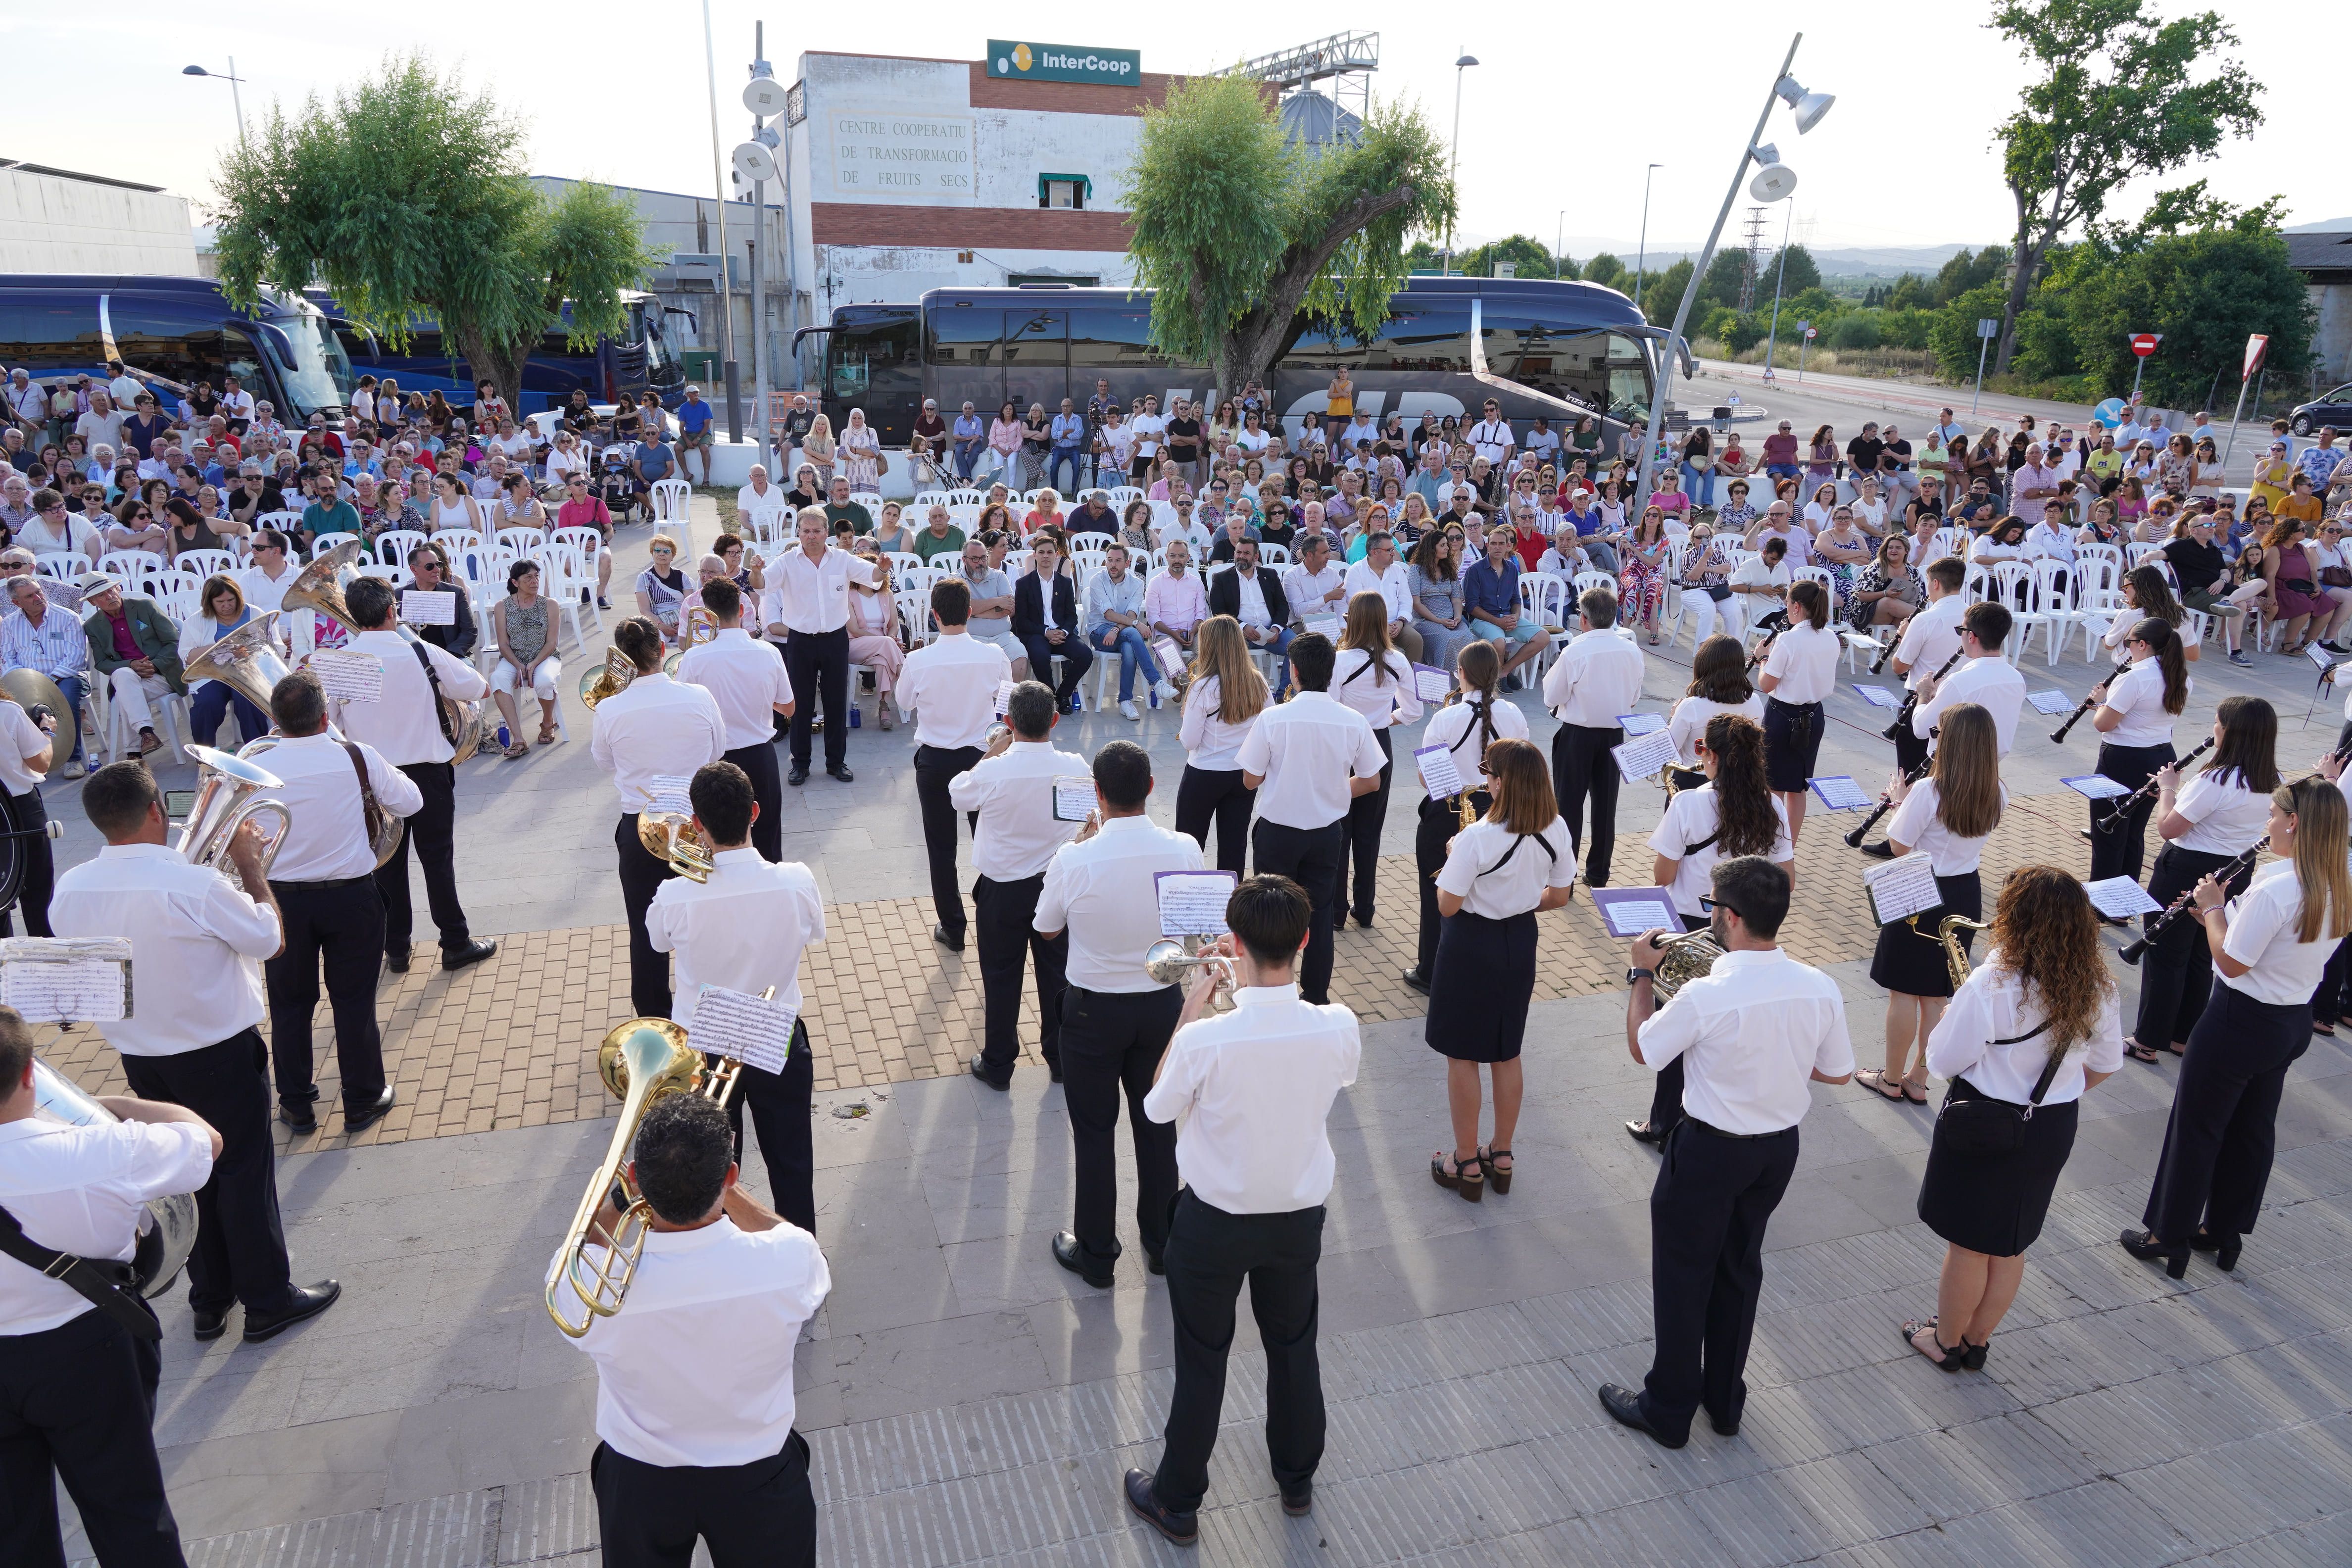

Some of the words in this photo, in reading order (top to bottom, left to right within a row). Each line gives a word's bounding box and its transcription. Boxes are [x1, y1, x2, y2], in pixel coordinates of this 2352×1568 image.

[1043, 53, 1131, 75] InterCoop
[839, 120, 885, 134] CENTRE
[893, 123, 966, 138] COOPERATIU
[841, 146, 857, 158] DE
[867, 147, 967, 163] TRANSFORMACIÓ
[843, 171, 859, 183] DE
[879, 172, 921, 185] FRUITS
[940, 174, 968, 187] SECS
